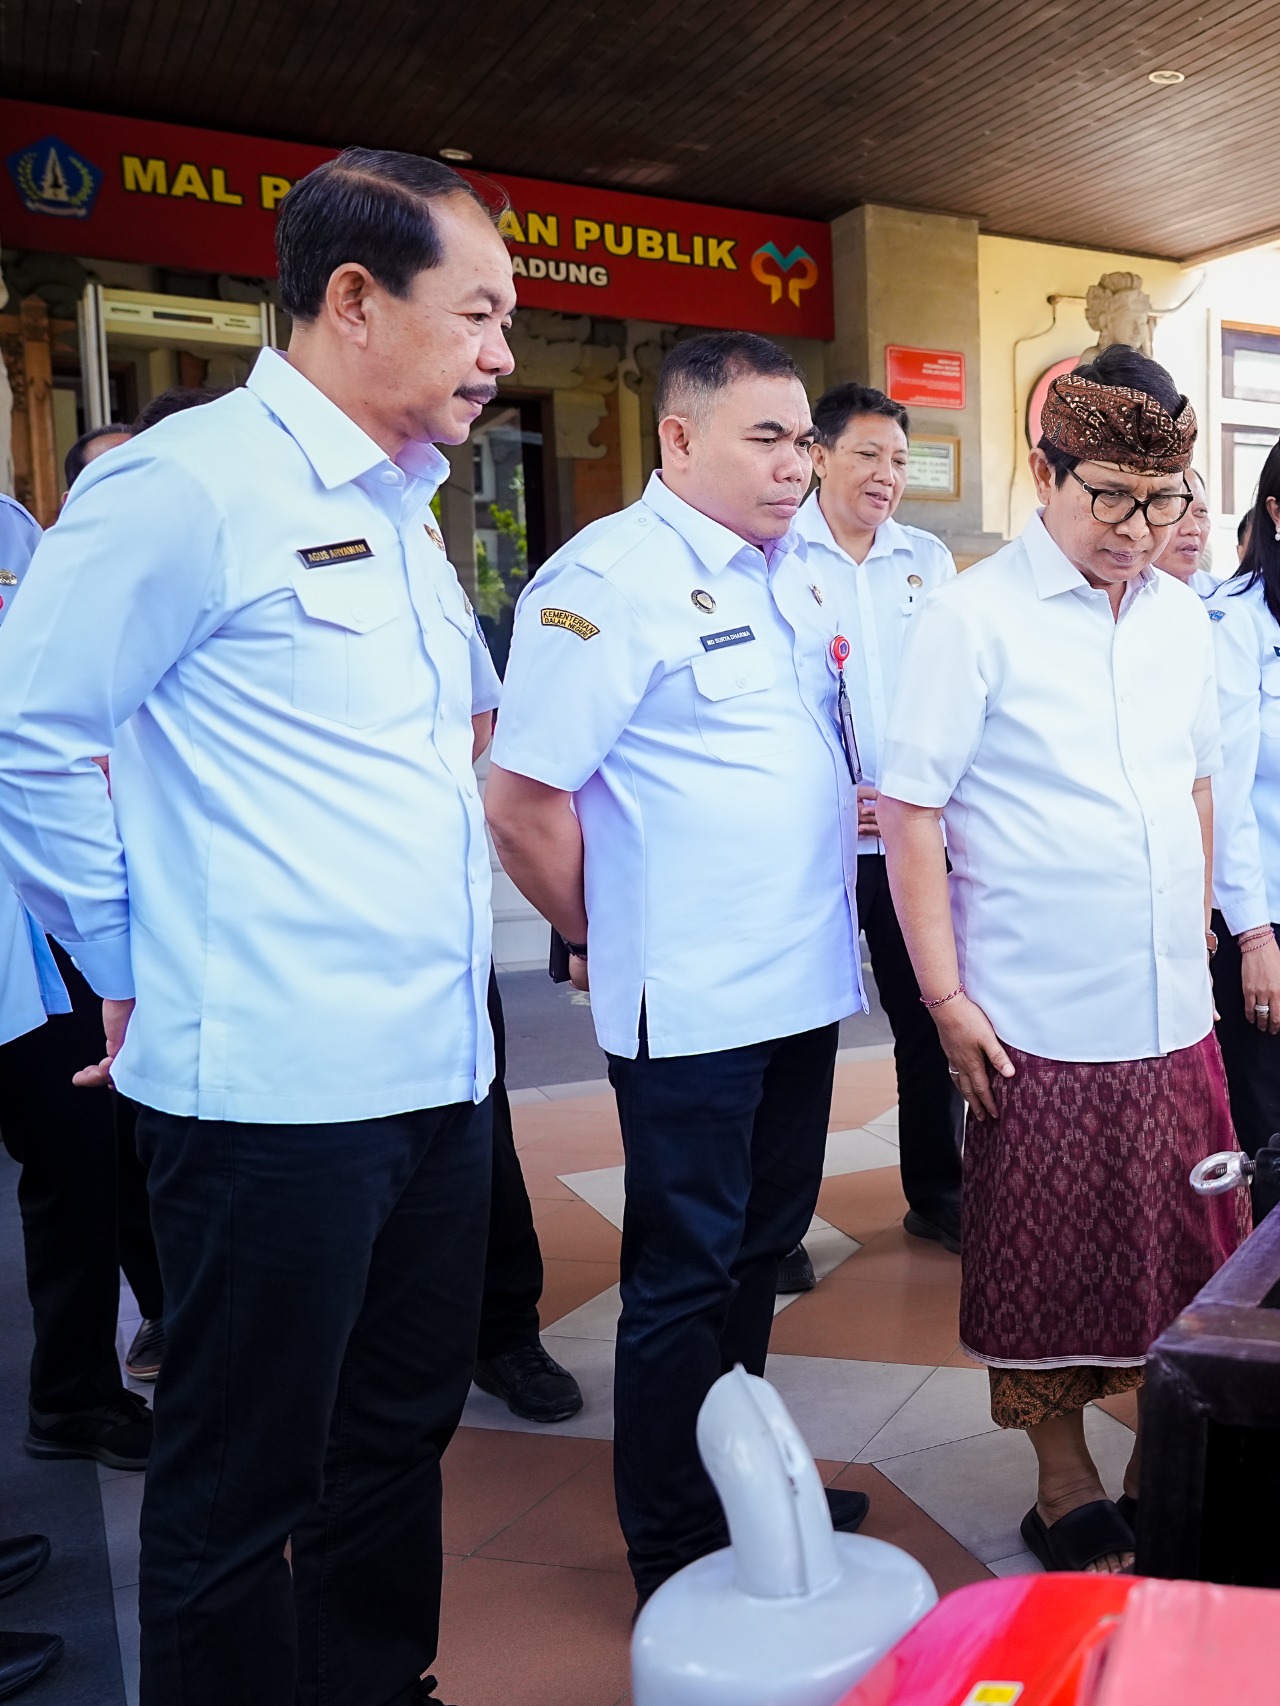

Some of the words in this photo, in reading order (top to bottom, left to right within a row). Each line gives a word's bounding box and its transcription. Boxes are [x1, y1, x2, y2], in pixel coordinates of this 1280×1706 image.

[122, 155, 243, 205] MAL
[574, 218, 738, 270] PUBLIK
[511, 255, 609, 287] ADUNG
[308, 550, 329, 562] AGUS
[329, 544, 366, 558] ARYAWAN
[543, 610, 597, 634] KEMENTERIAN
[544, 617, 567, 626] DALAM
[567, 622, 588, 637] NEGERI
